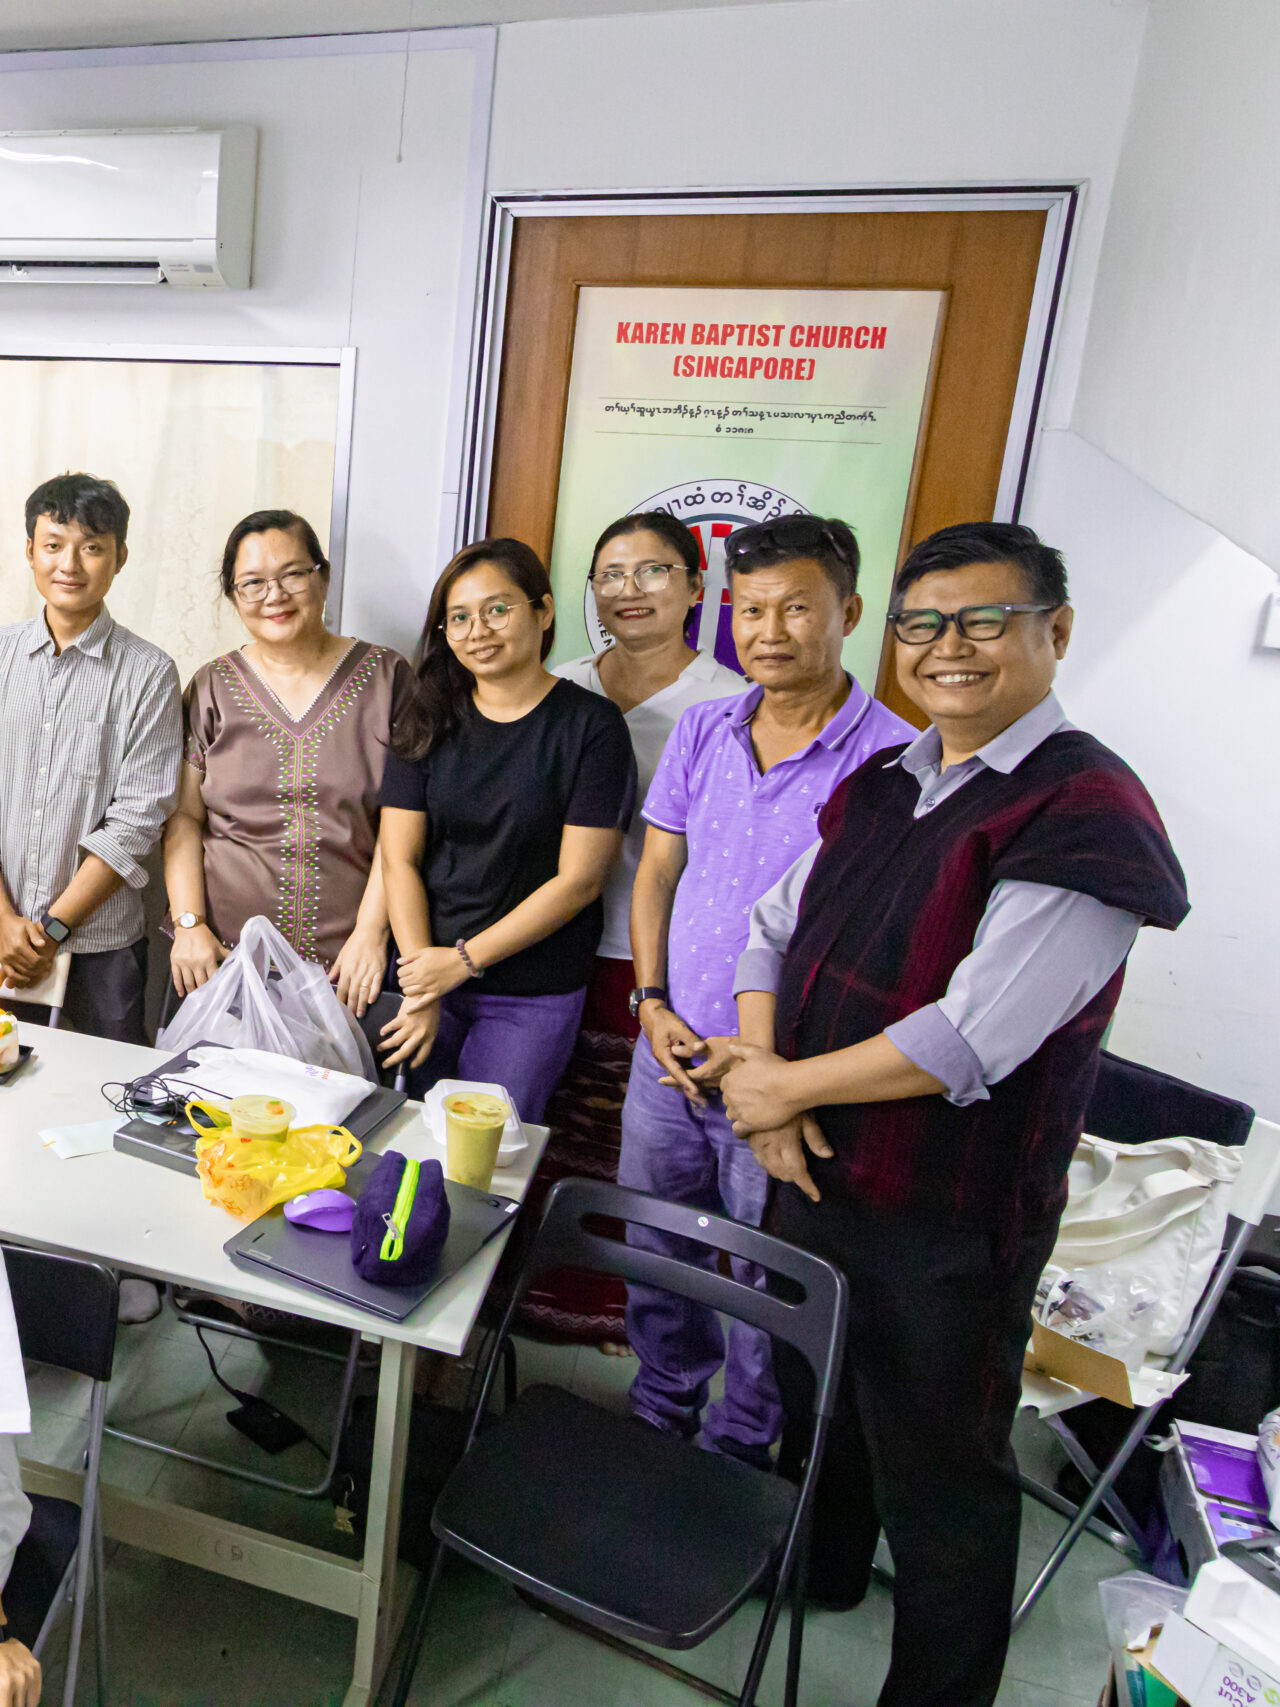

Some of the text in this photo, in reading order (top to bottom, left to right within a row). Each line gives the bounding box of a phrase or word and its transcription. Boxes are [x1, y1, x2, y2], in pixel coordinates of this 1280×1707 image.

[616, 321, 888, 350] KAREN BAPTIST CHURCH
[672, 354, 816, 381] (SINGAPORE)
[1223, 1675, 1256, 1703] A300
